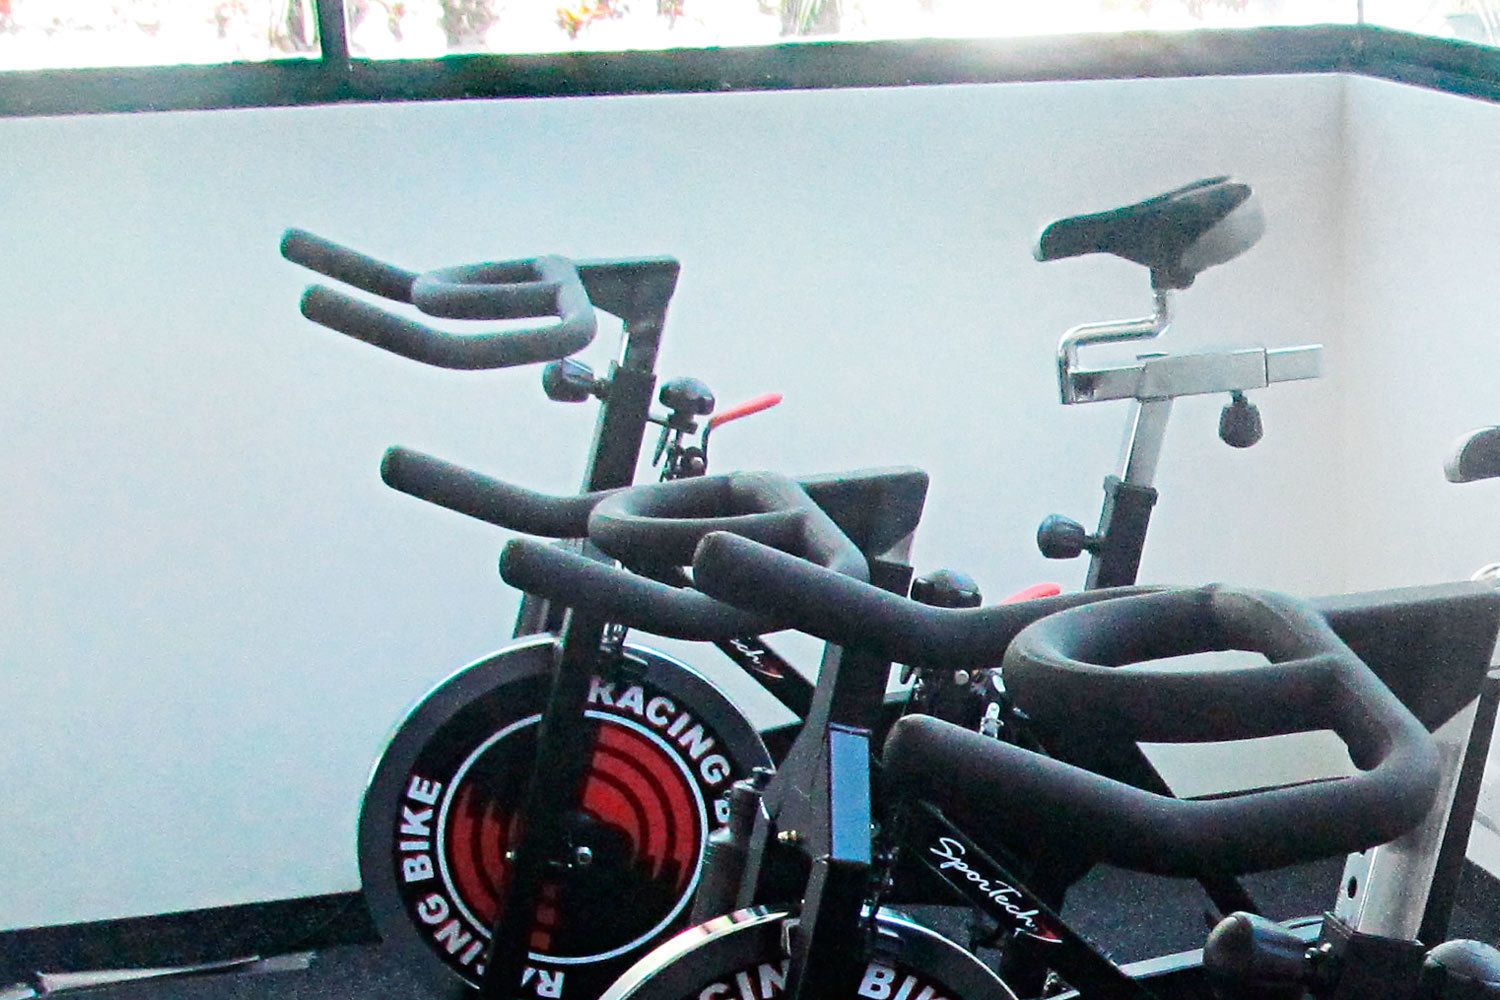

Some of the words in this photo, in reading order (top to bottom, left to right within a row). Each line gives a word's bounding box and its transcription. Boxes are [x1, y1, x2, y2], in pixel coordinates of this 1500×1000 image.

[588, 675, 732, 786] RACING
[399, 774, 442, 883] BIKE
[416, 892, 565, 999] RING
